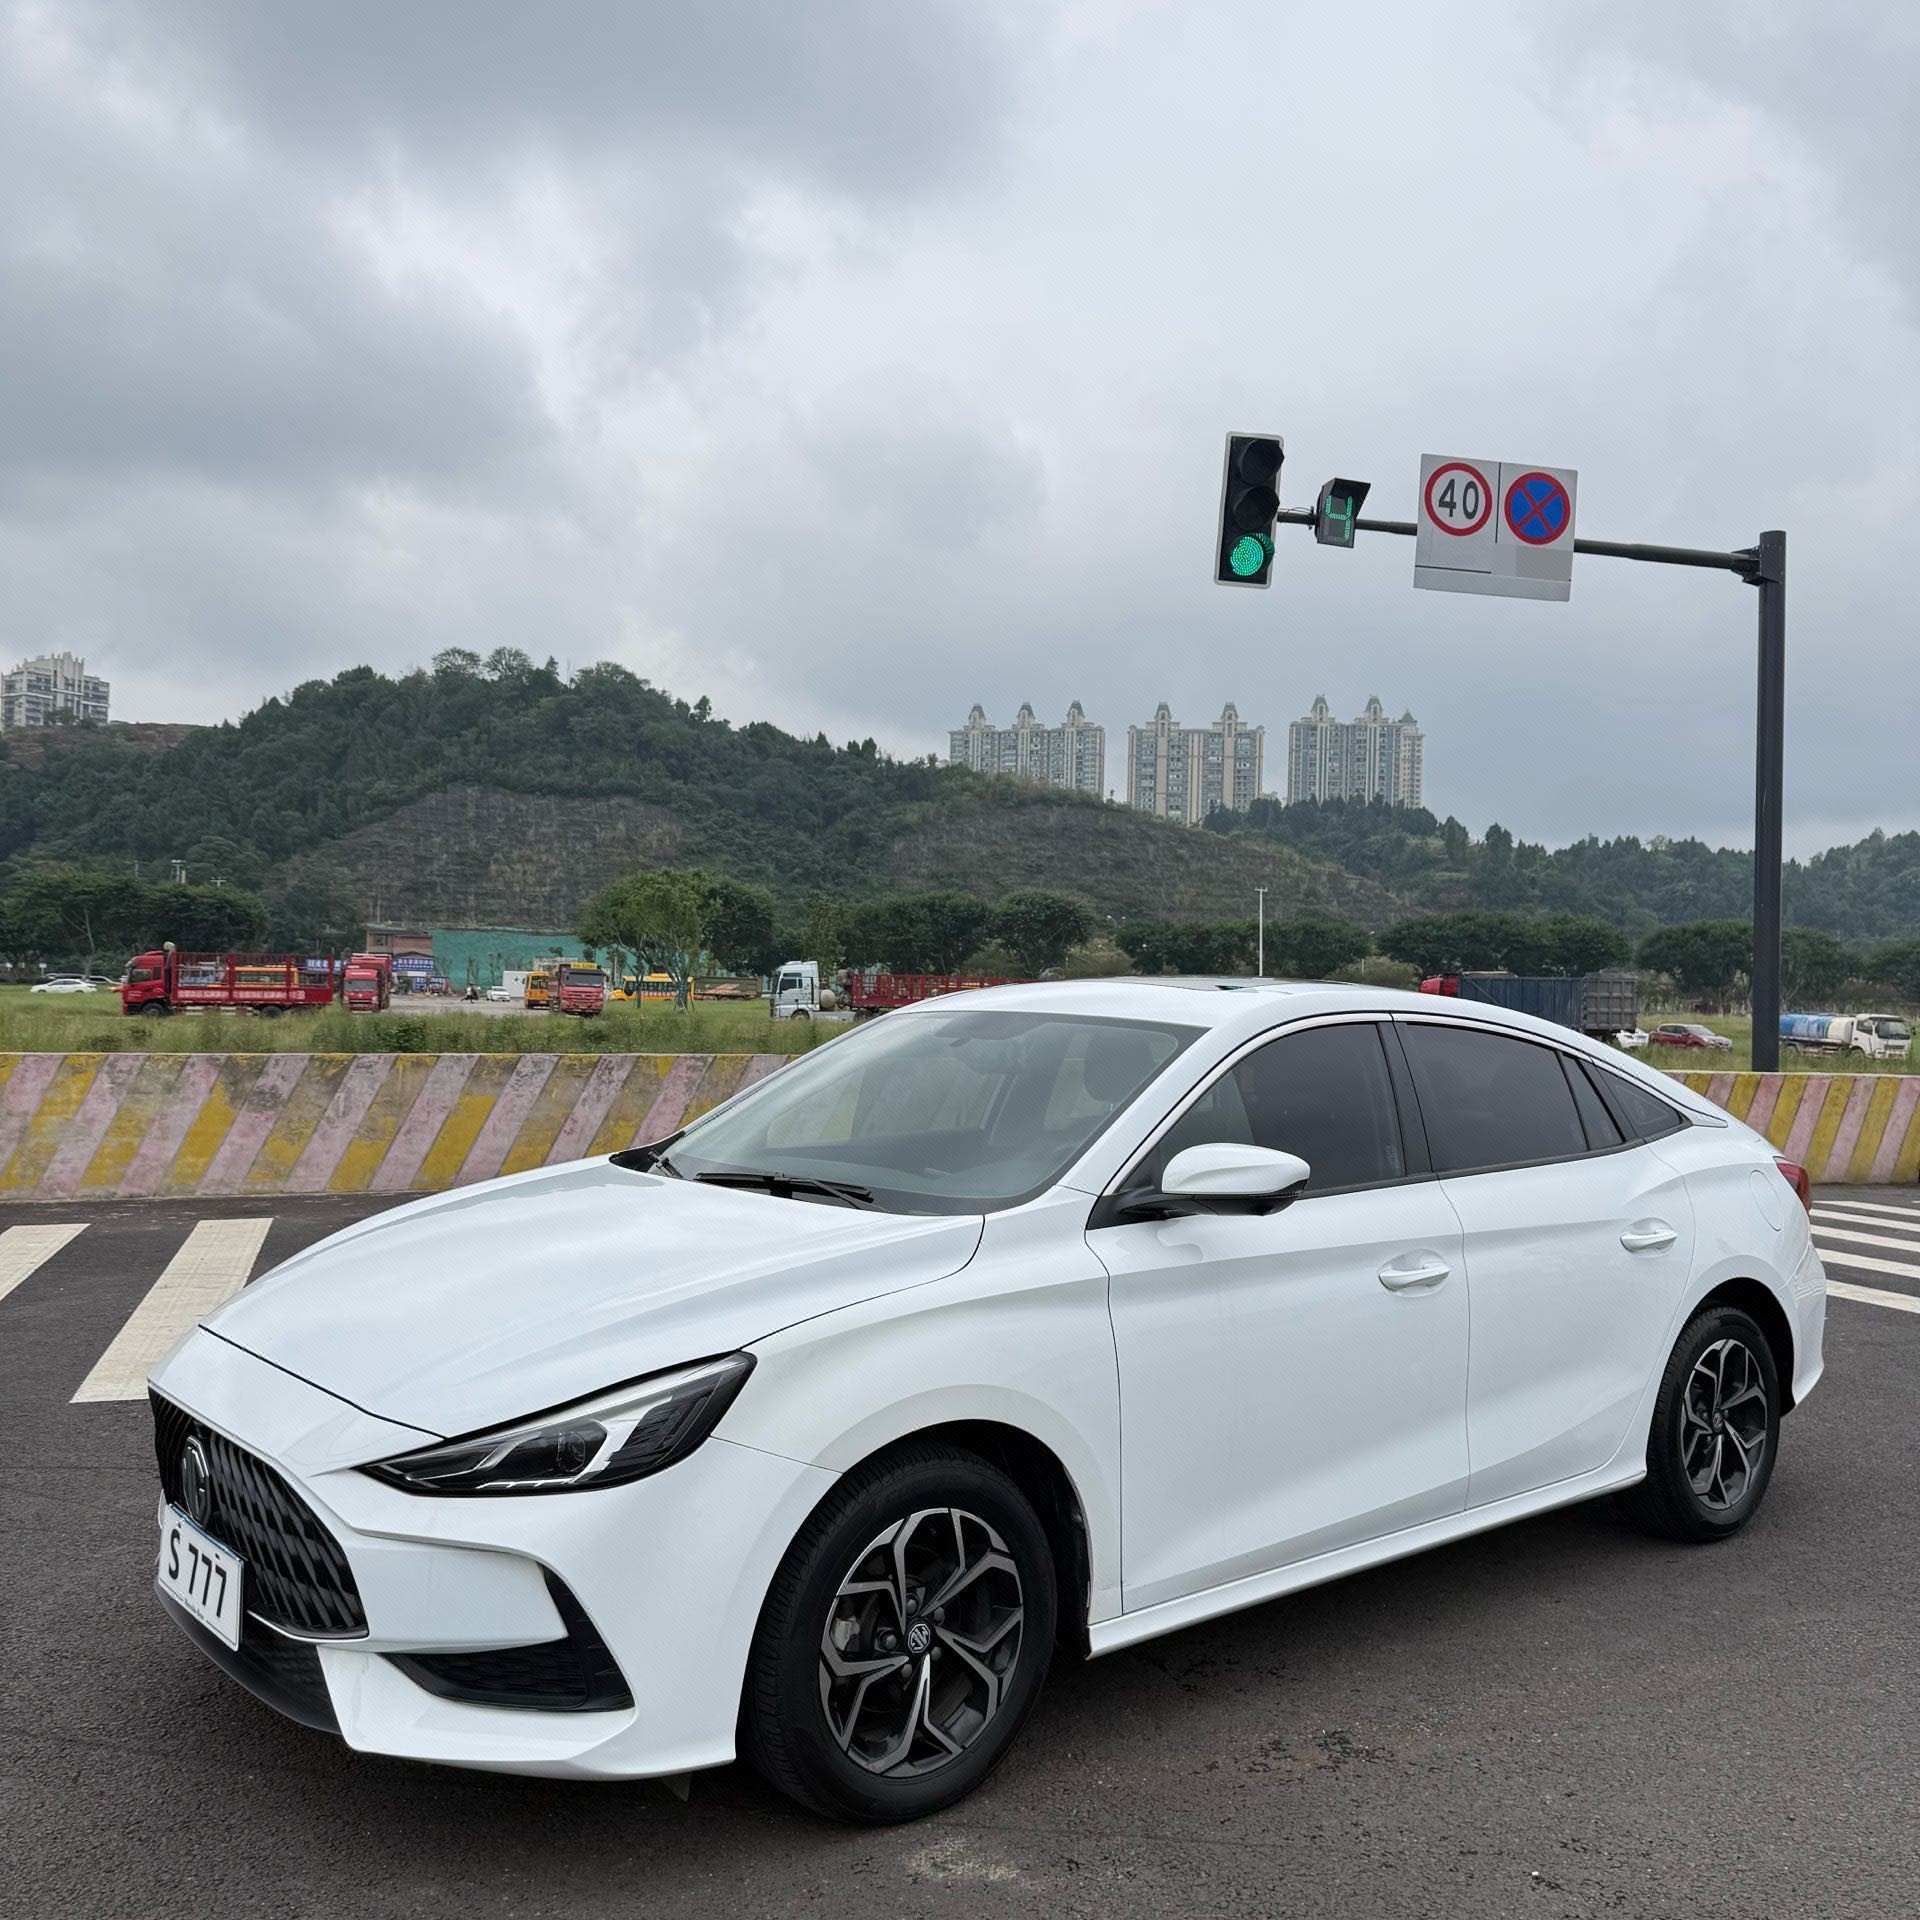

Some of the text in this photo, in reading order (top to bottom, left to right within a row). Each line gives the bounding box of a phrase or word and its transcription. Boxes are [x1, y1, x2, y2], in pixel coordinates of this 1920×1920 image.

[1326, 494, 1353, 541] 4
[1439, 478, 1479, 519] 40
[169, 1528, 226, 1618] S 777
